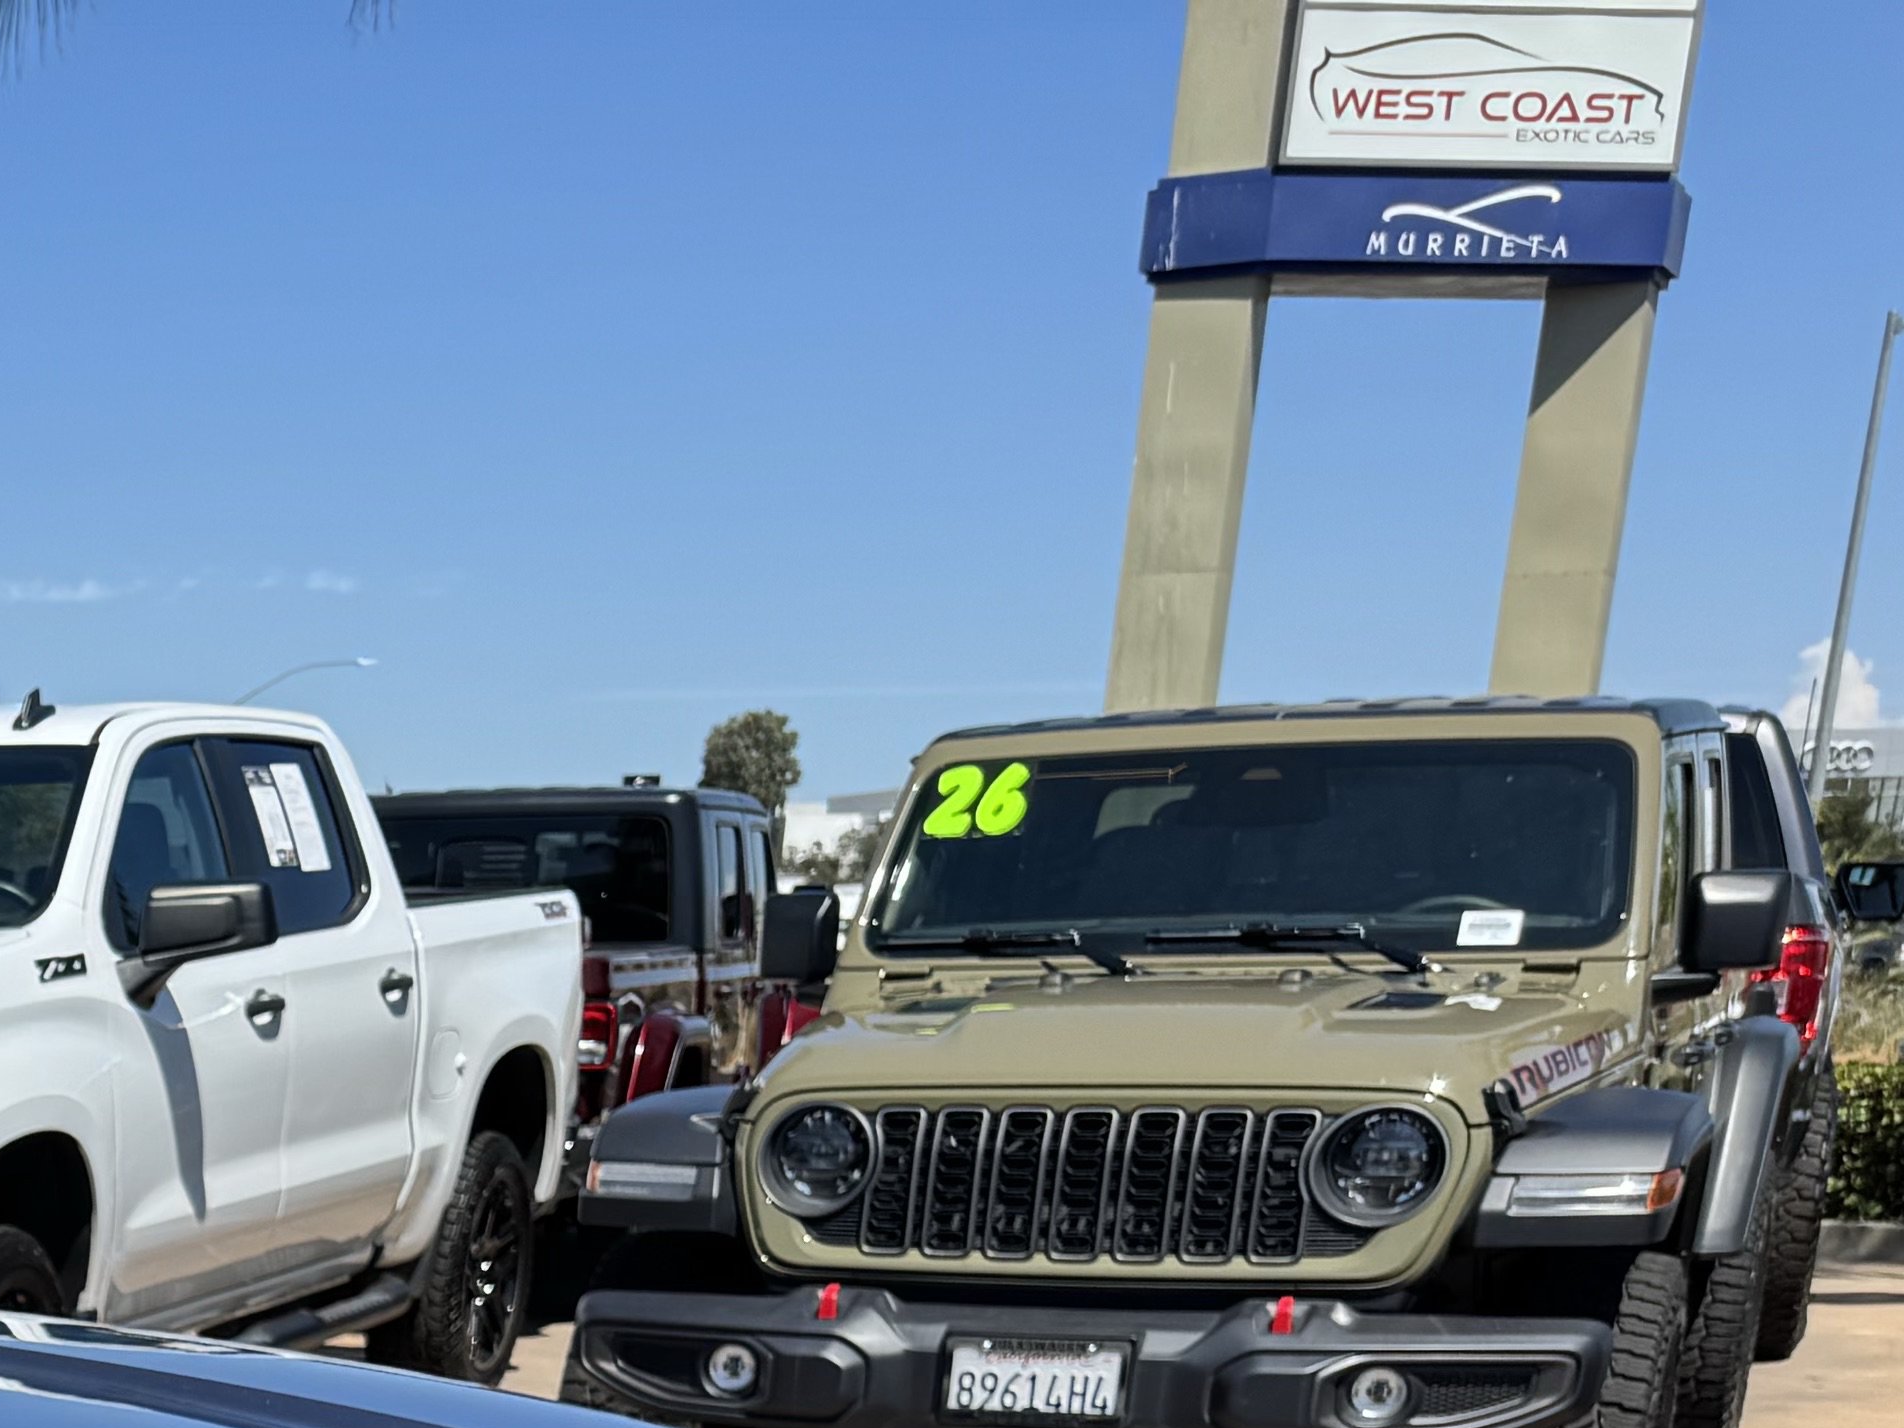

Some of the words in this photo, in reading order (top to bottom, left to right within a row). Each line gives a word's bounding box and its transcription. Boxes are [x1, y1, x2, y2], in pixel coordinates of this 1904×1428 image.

[1332, 87, 1466, 121] WEST
[1480, 91, 1647, 125] COAST
[1515, 128, 1590, 144] EXOTIC
[1595, 129, 1656, 145] CARS
[1365, 231, 1570, 259] MURRIETA
[923, 762, 1030, 839] 26
[956, 1371, 1109, 1416] 89614H4
